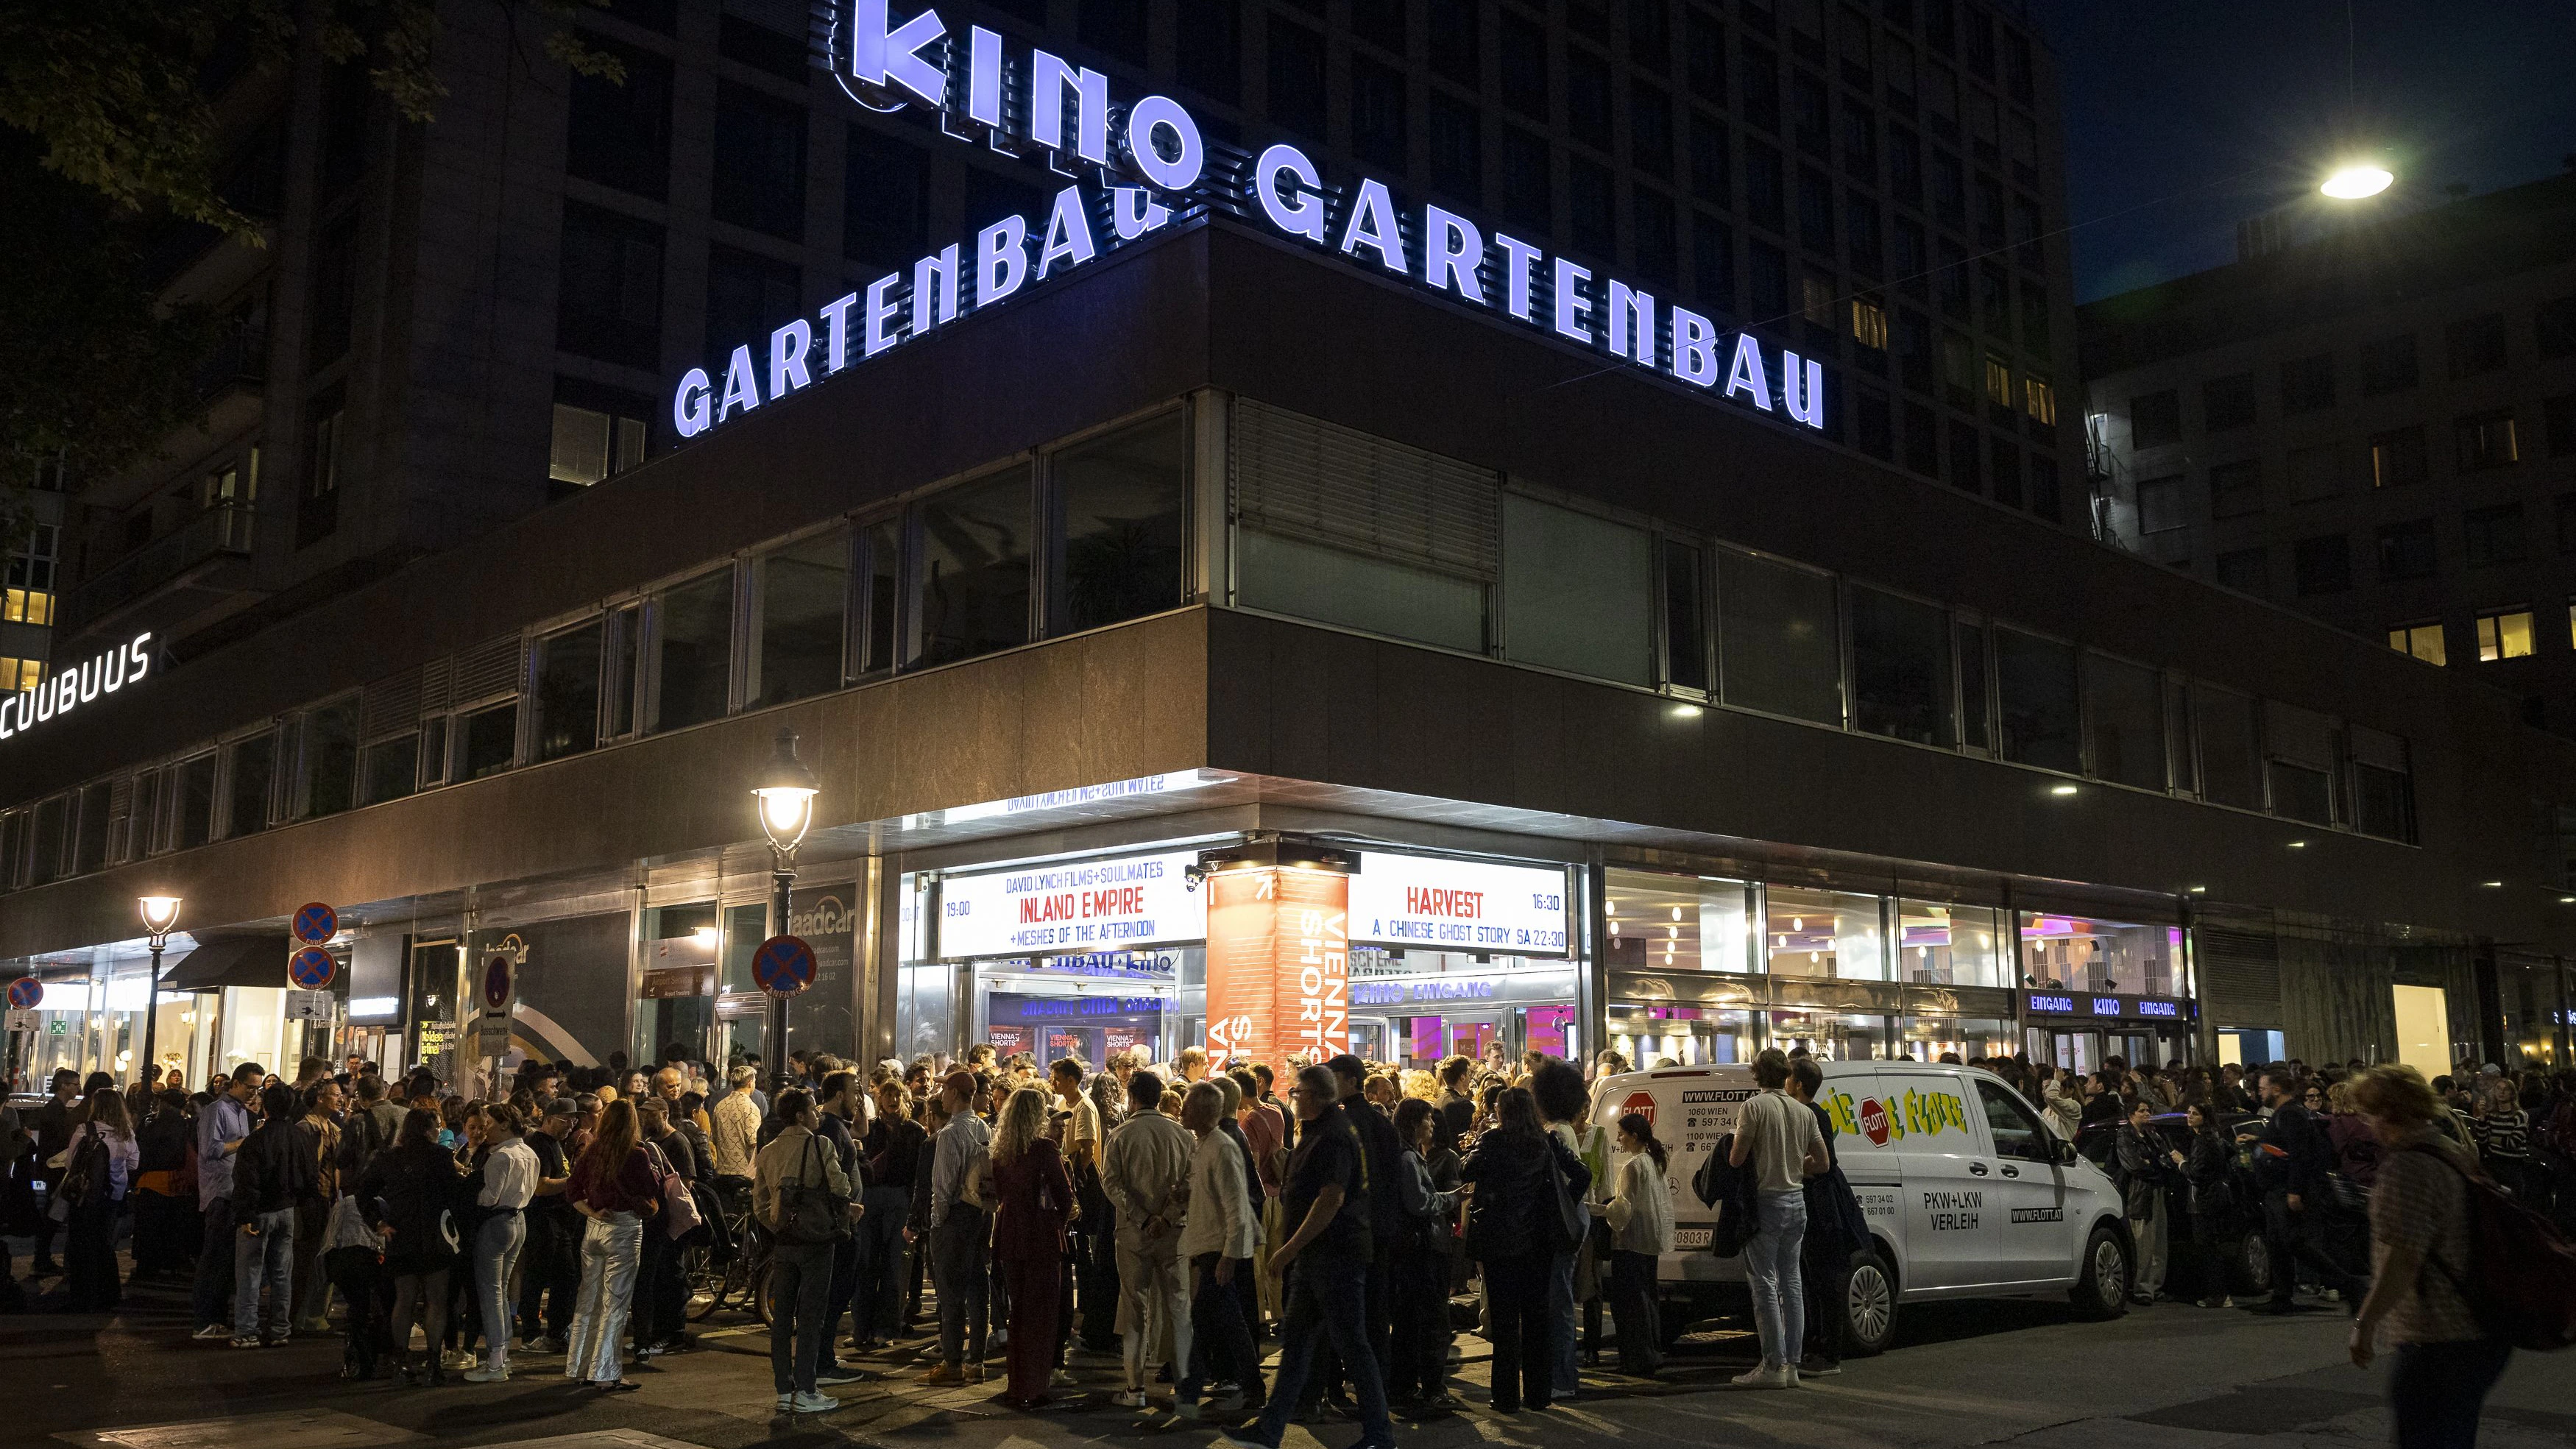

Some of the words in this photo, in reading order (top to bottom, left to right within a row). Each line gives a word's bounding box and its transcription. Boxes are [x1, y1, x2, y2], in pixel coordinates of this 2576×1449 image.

[853, 0, 1203, 191] KINO
[1256, 144, 1822, 429] GARTENBAU
[673, 185, 1169, 438] GARTENBAU
[0, 631, 152, 740] CUUBUUS
[1006, 876, 1033, 893] DAVID
[1035, 874, 1063, 890] LYNCH
[946, 901, 970, 917] 19:00
[1020, 893, 1074, 924] INLAND
[1083, 886, 1144, 918] EMPIRE
[1407, 886, 1484, 918] HARVEST
[1532, 893, 1560, 911] 16:30
[1059, 927, 1070, 943] OF
[1076, 924, 1095, 942] THE
[1100, 920, 1155, 940] AFTERNOON
[1373, 918, 1381, 935] A
[1390, 920, 1434, 939] CHINESE
[1440, 924, 1472, 941] GHOST
[1477, 926, 1510, 944] STORY
[1517, 929, 1531, 945] SA
[1533, 930, 1564, 947] 22:30
[767, 987, 803, 999] ANFANG
[1301, 910, 1322, 1066] SHORTS
[1325, 912, 1345, 1060] VIENNA
[1354, 983, 1404, 1004] KINO
[1414, 981, 1493, 1000] EINGANG
[2031, 996, 2073, 1011] EINGANG
[2093, 998, 2120, 1015] KINO
[2140, 1002, 2176, 1016] EINGANG
[1702, 1118, 1717, 1127] 597
[1721, 1118, 1731, 1126] 34
[1864, 1112, 1888, 1133] FLOTT
[1706, 1132, 1727, 1140] WIEN
[1701, 1143, 1716, 1152] 66
[1866, 1195, 1876, 1204] 597
[1878, 1195, 1886, 1203] 34
[1886, 1195, 1894, 1203] 02
[1923, 1191, 1982, 1209] PKW+LKW
[1867, 1207, 1877, 1215] 667
[1878, 1207, 1885, 1215] 01
[2011, 1208, 2063, 1222] WWW.FLOTT.AT
[1931, 1213, 1978, 1230] VERLEIH
[1675, 1231, 1702, 1244] 0803
[1703, 1232, 1710, 1244] R
